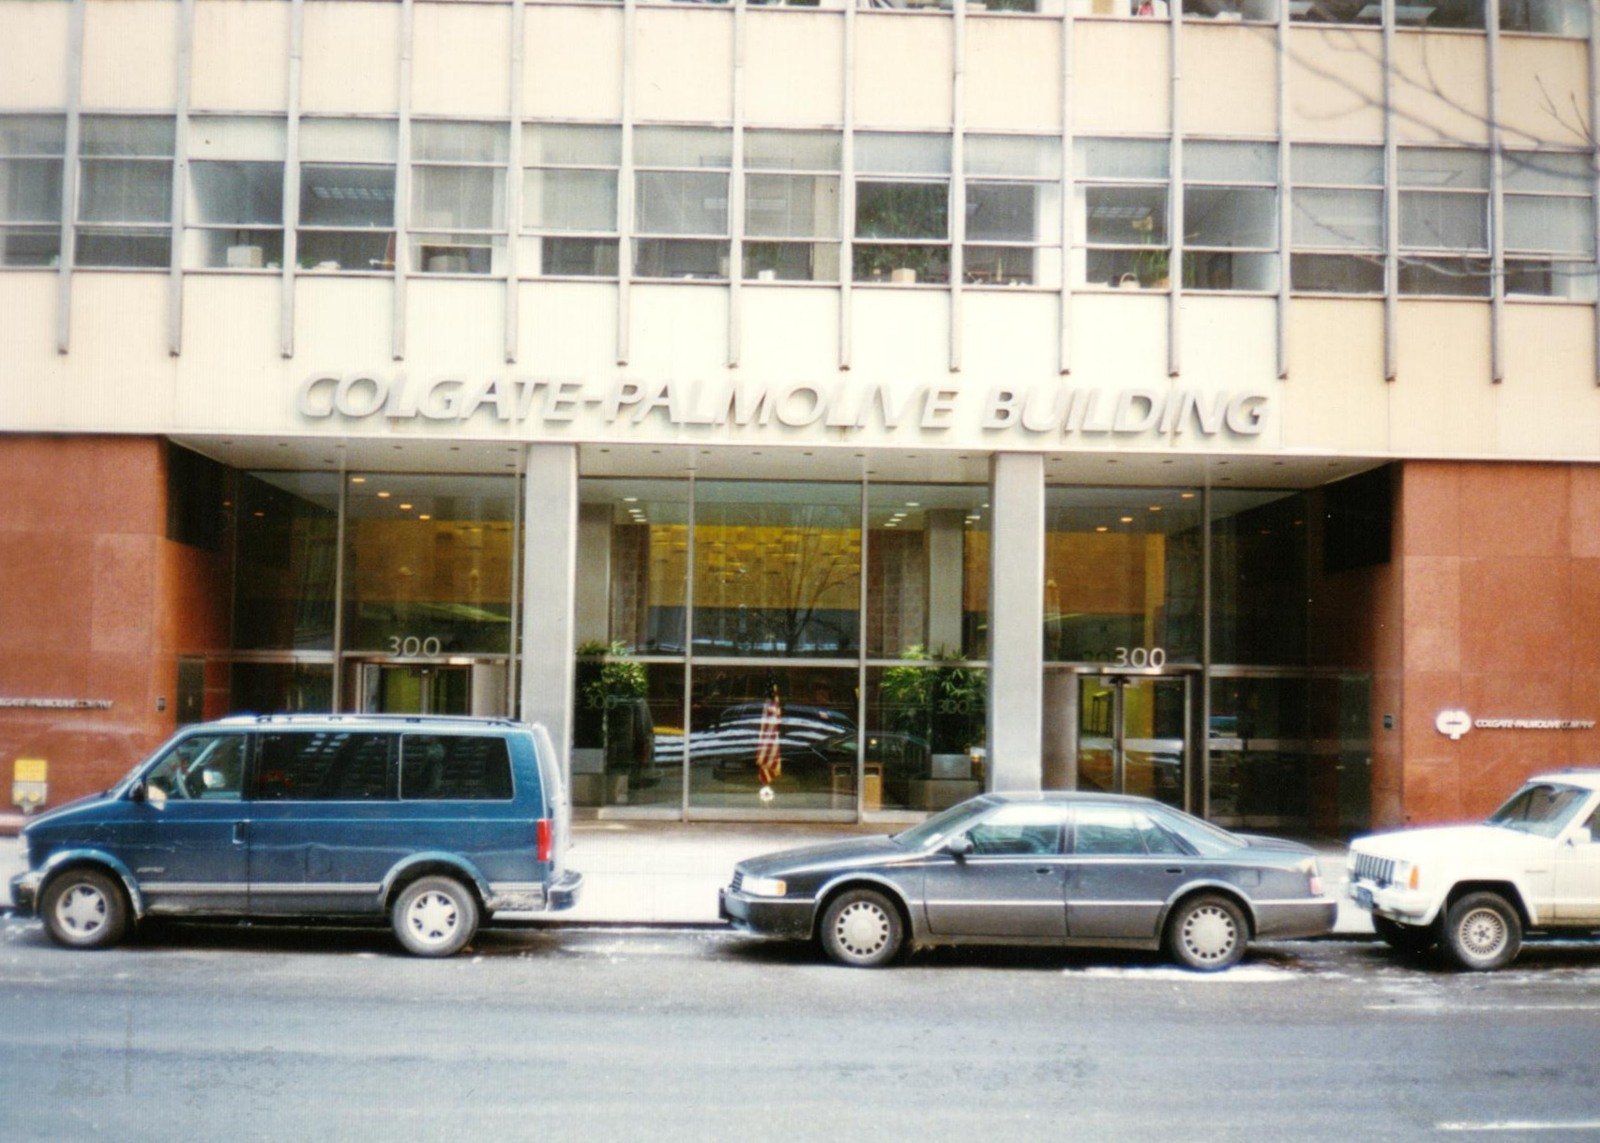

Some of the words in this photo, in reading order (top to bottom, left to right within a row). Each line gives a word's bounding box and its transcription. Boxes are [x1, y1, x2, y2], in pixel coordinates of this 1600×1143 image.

[299, 375, 960, 430] COLGATE-PALMOLIVE
[981, 385, 1269, 435] BUILDING
[387, 636, 441, 657] 300
[1114, 647, 1166, 669] 300
